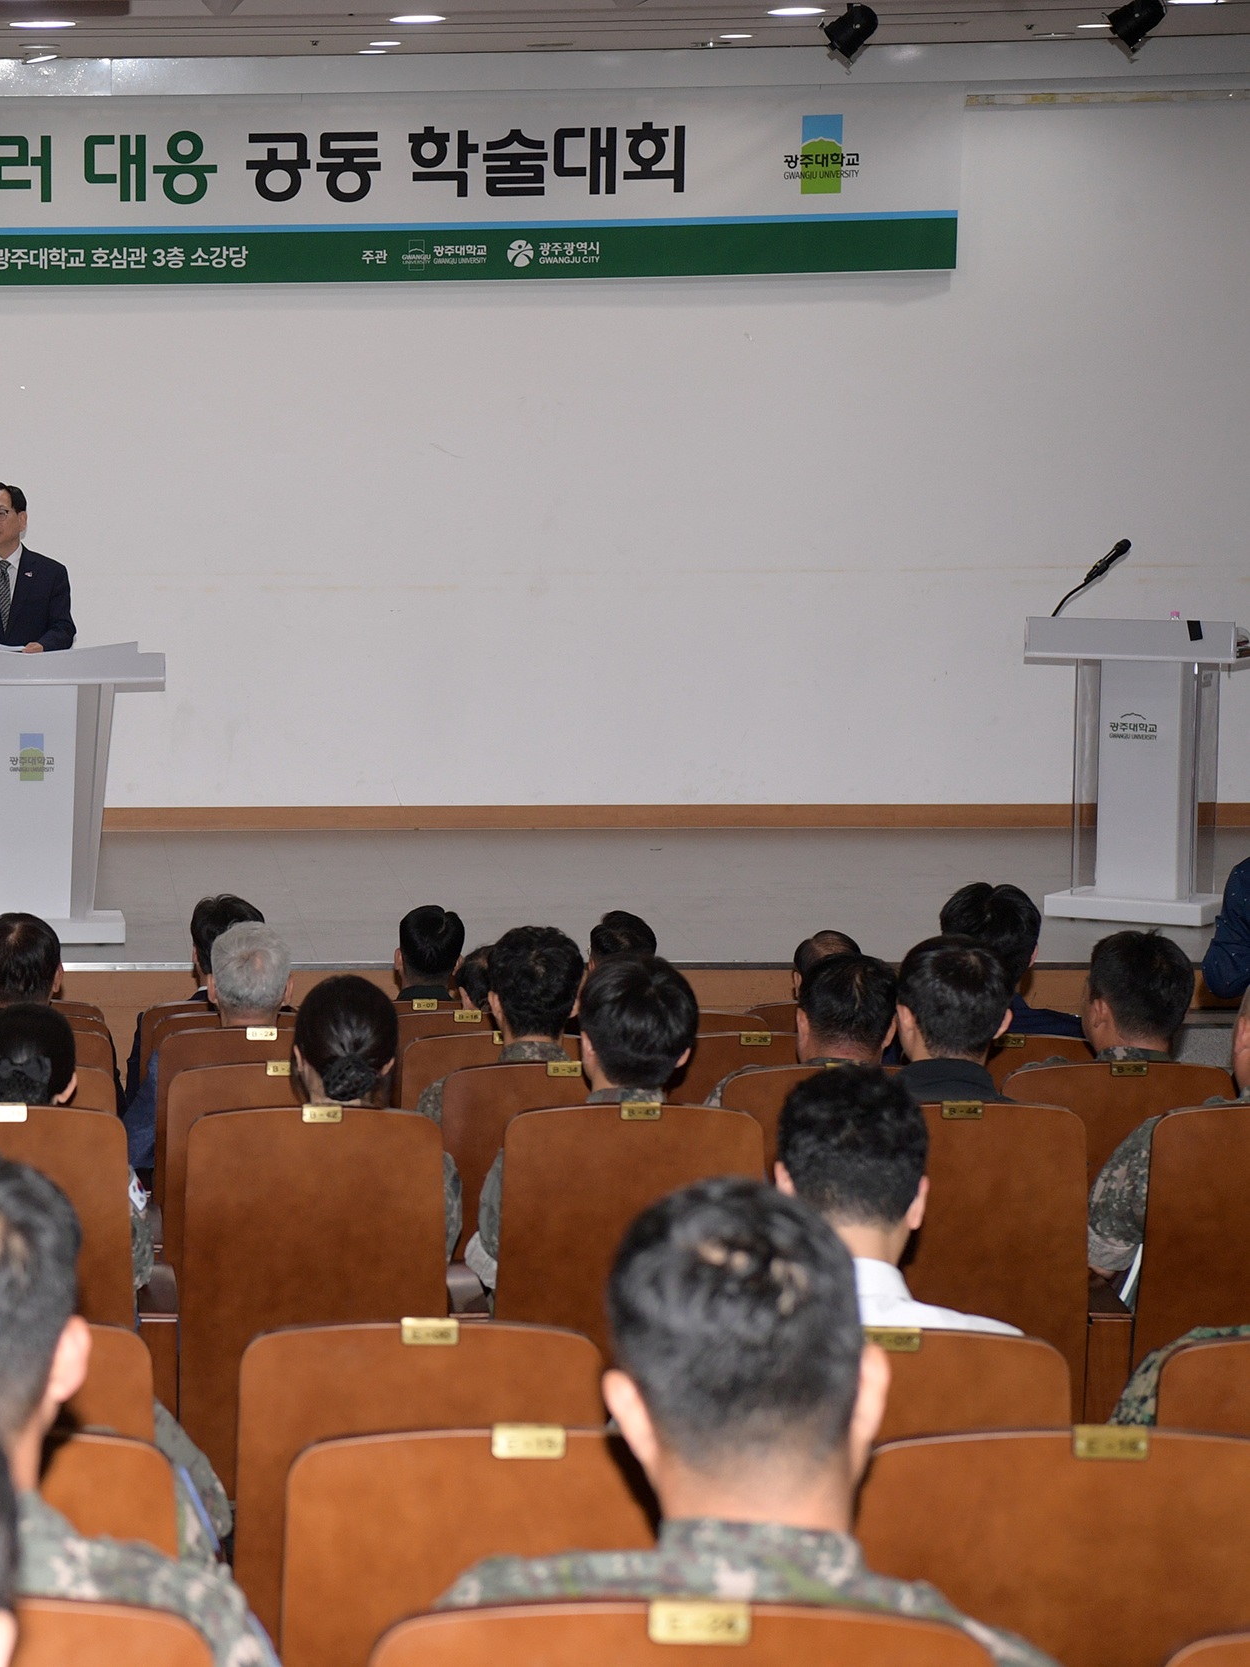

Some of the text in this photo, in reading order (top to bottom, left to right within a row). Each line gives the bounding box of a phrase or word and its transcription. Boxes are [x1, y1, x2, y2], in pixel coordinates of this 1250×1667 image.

[83, 130, 218, 205] 대응
[245, 131, 382, 203] 공동
[408, 121, 686, 198] 학술대회
[784, 152, 860, 169] 광주대학교
[783, 169, 860, 180] GWANGJU UNIVERSITY
[433, 244, 487, 257] 광주대학교
[538, 241, 600, 256] 광주광역시
[90, 246, 148, 269] 호심관
[152, 246, 186, 269] 3층
[189, 245, 249, 268] 소강당
[361, 249, 388, 265] 주관
[401, 253, 431, 261] GWANGJU
[433, 257, 487, 266] GWANGJU UNIVERSITY
[538, 255, 600, 265] GWANGJU CITY
[1109, 722, 1157, 733] 광주대학교
[9, 756, 55, 766] 광주대학교
